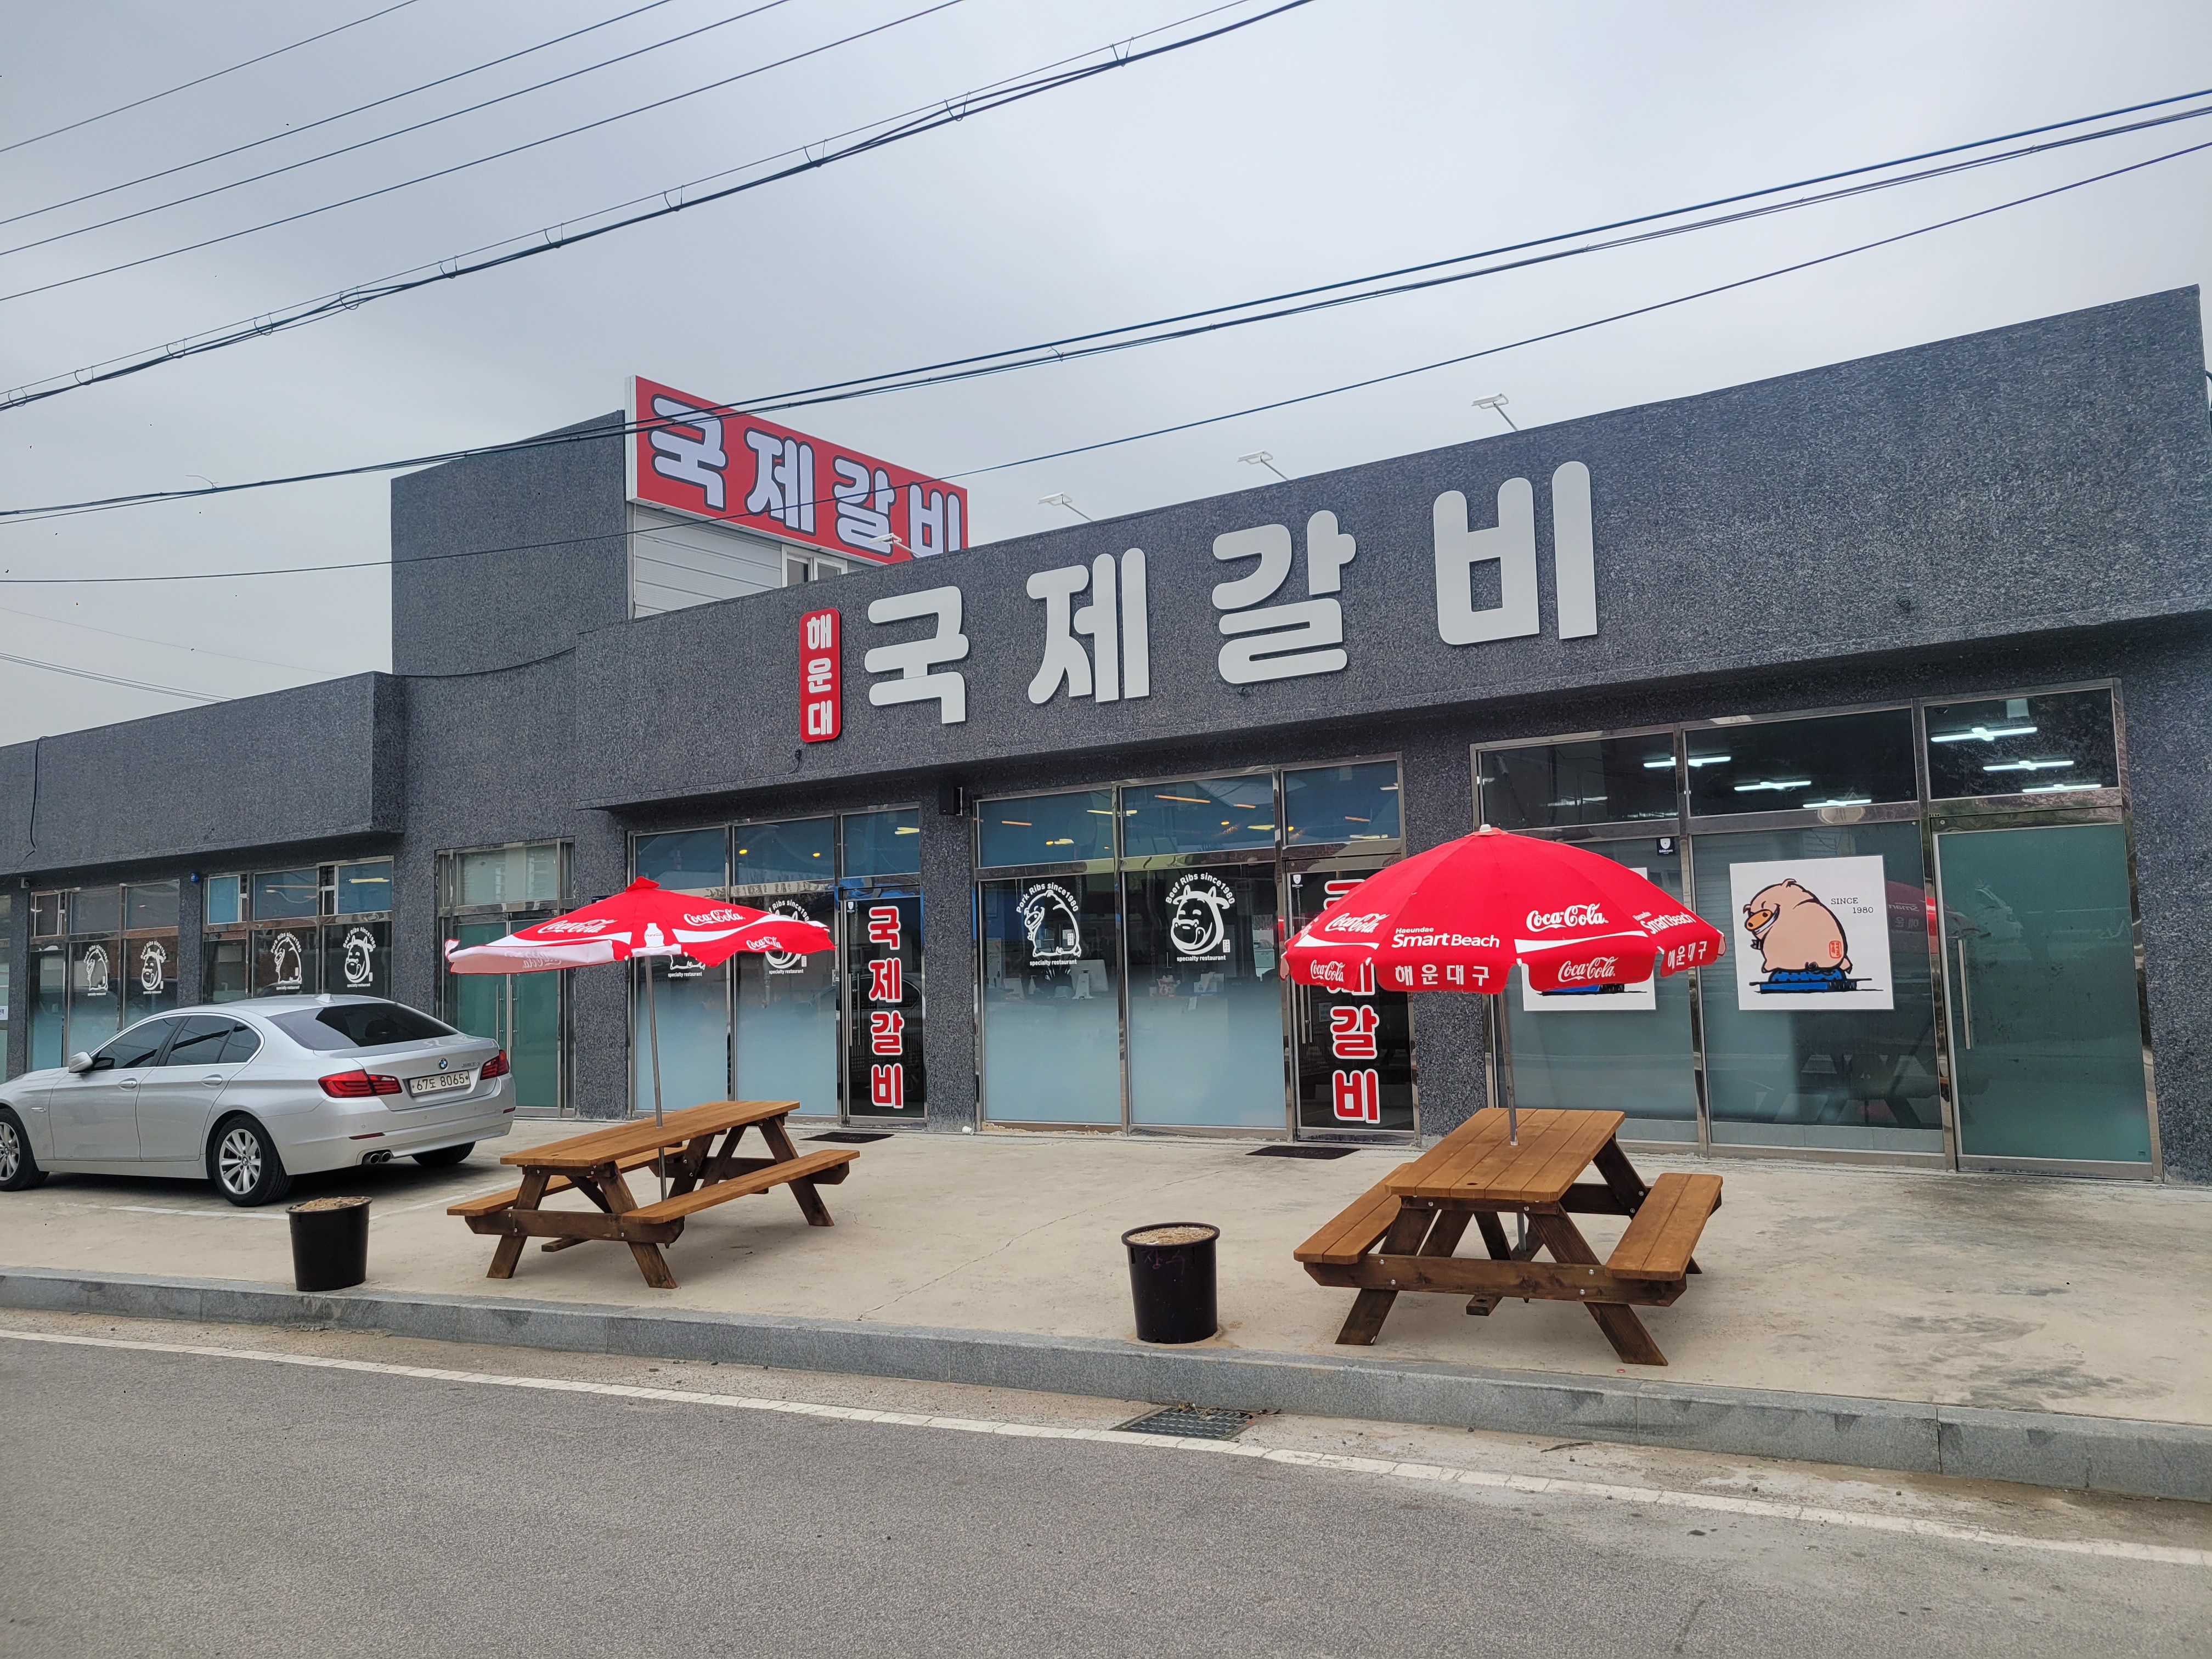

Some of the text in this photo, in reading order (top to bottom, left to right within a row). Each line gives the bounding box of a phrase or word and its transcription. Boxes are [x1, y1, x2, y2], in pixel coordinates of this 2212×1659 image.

[650, 393, 961, 558] 국제갈비
[865, 461, 1598, 724] 국제갈비
[807, 613, 832, 735] 해운대
[1016, 882, 1079, 913] Pork Ribs since1980
[1165, 872, 1235, 904] Beef Ribs since1980
[684, 909, 744, 926] Coca-Cola
[772, 899, 810, 922] Ribs since198
[1324, 913, 1389, 933] Coca-Cola
[1526, 902, 1606, 932] Coca-Cola
[277, 933, 286, 941] Ribs
[1391, 933, 1500, 948] Smart Beach
[1310, 960, 1346, 982] Coca-Cola
[1395, 964, 1489, 986] 해운대구
[1558, 956, 1618, 983] Coca-Cola
[868, 906, 904, 1109] 국제갈비
[416, 1074, 465, 1091] 67도 8065
